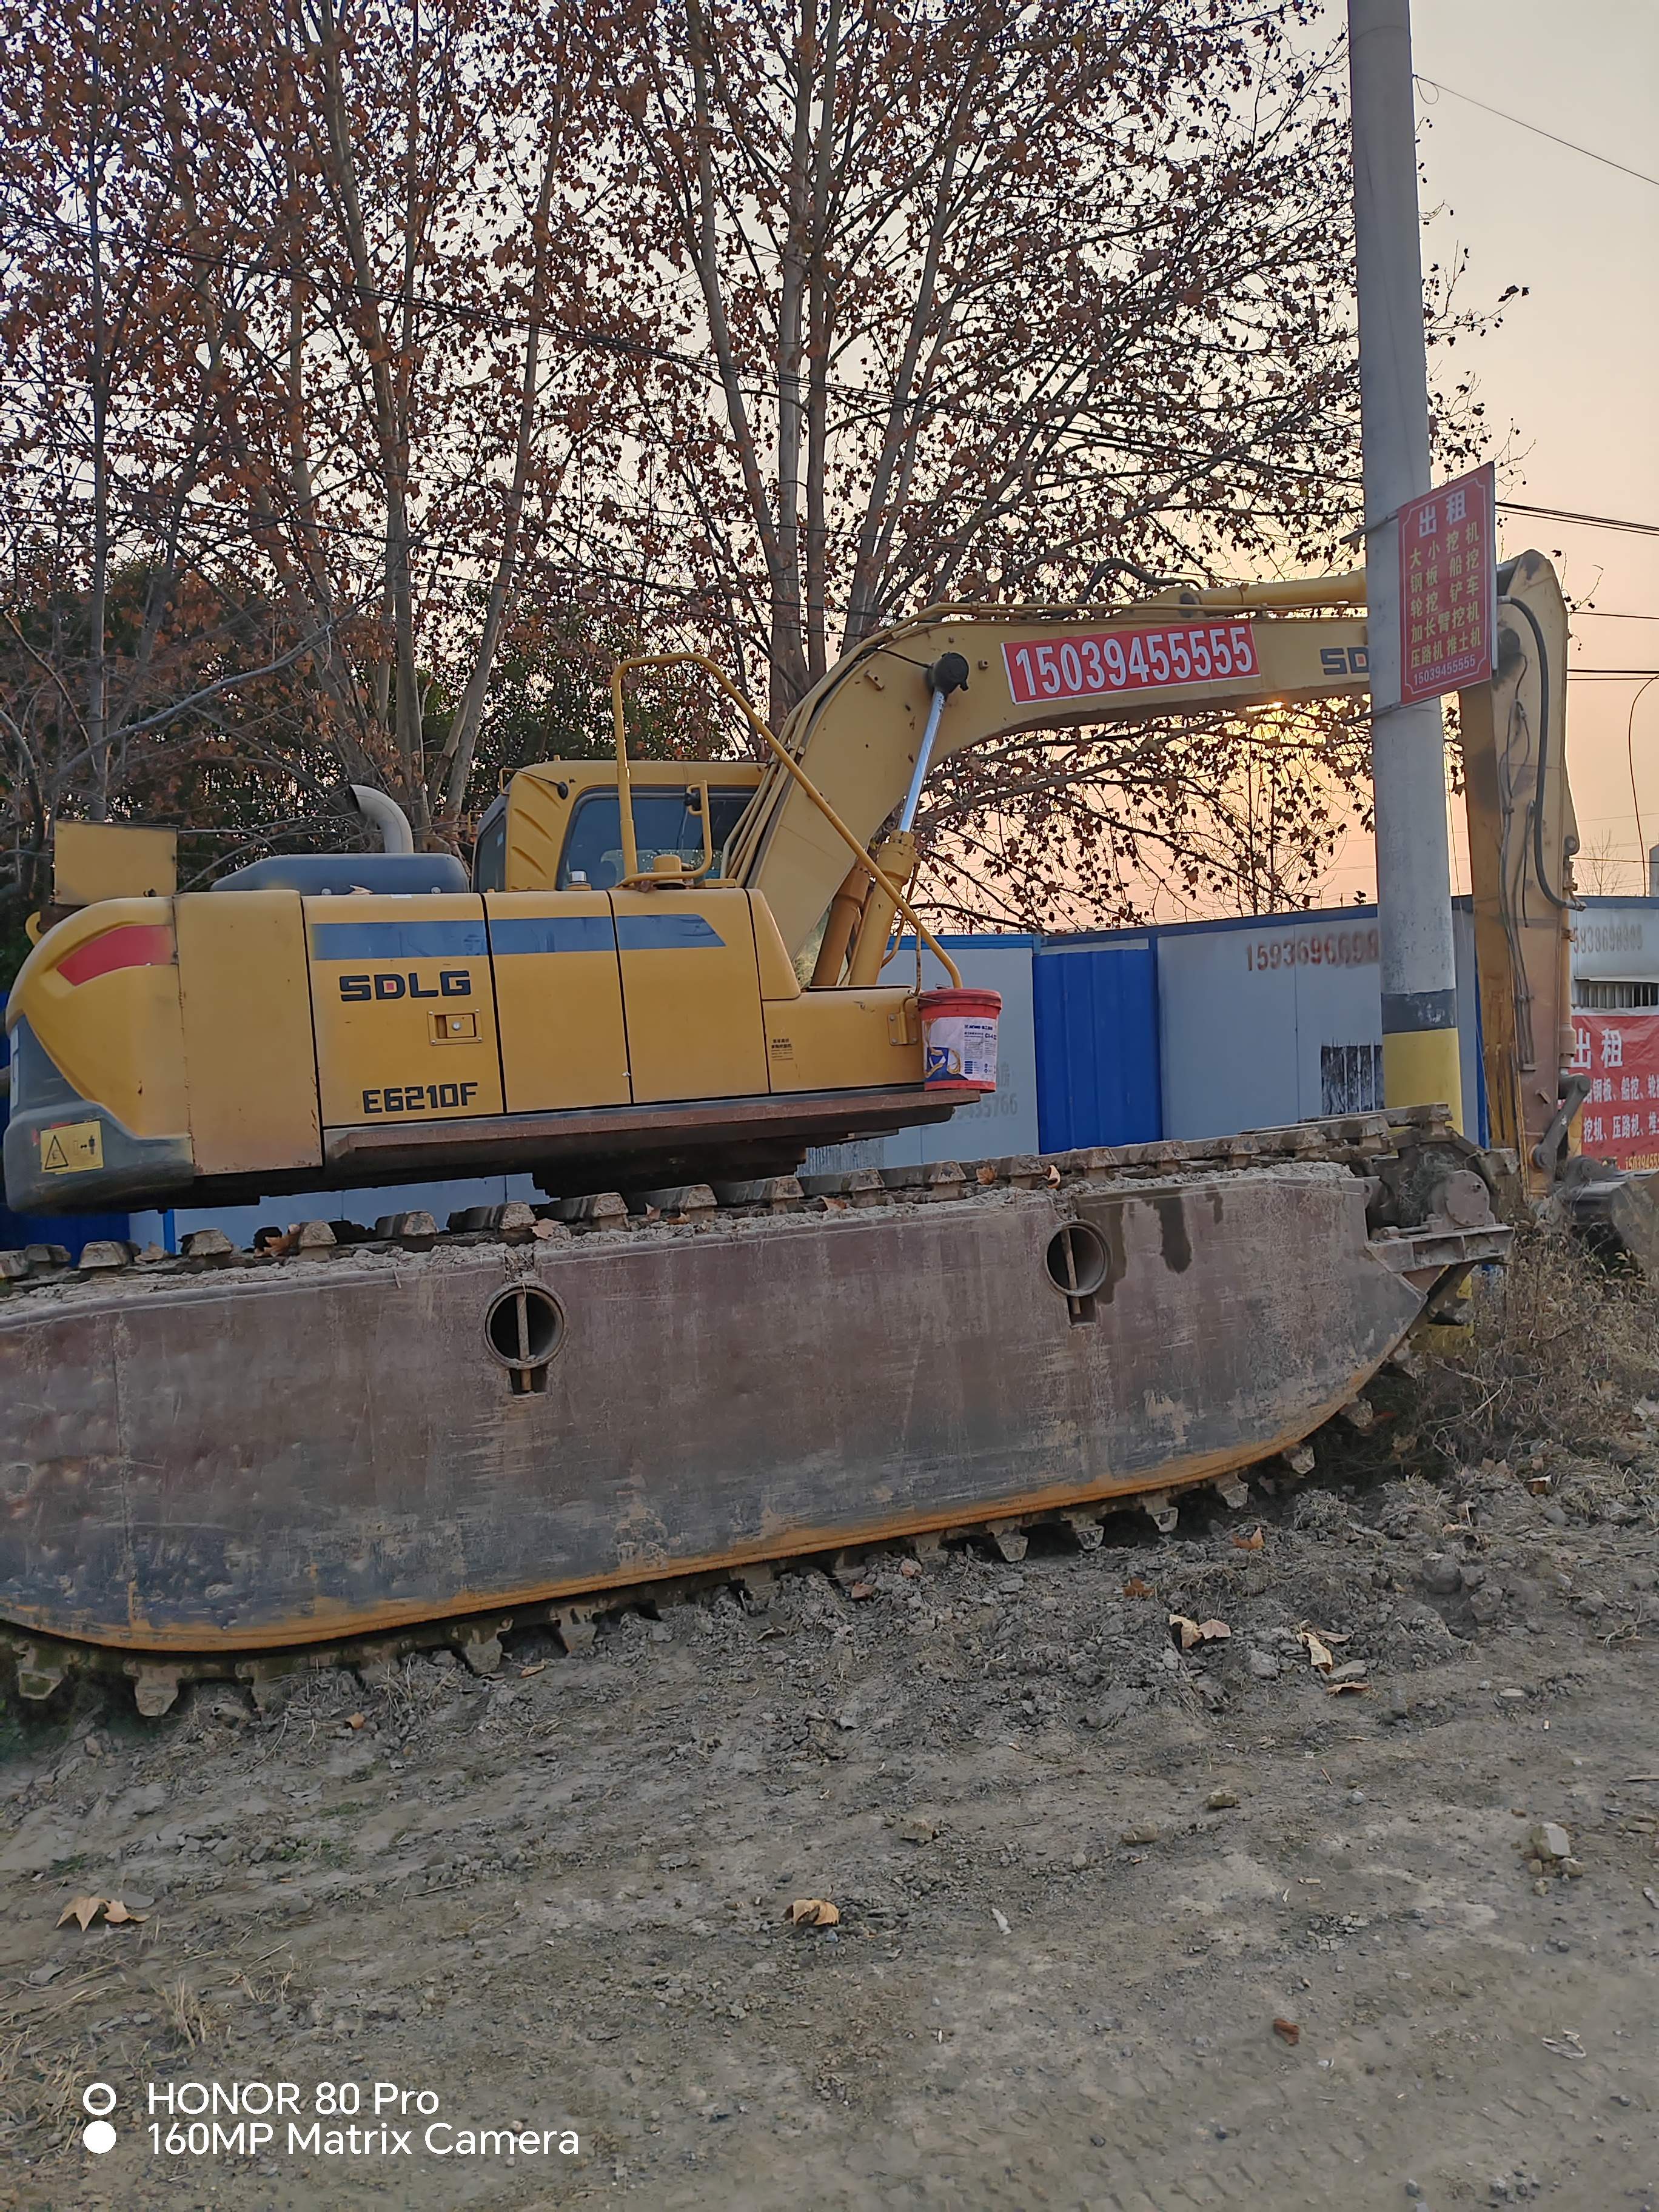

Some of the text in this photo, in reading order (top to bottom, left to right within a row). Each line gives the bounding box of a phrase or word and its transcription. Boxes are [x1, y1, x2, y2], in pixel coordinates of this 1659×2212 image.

[1418, 490, 1466, 538] 出租
[1410, 521, 1480, 570] 大小挖机
[1410, 548, 1480, 594] 钢板 船挖
[1410, 575, 1480, 619] 轮挖 铲车
[1410, 601, 1480, 644] 加长臂挖机
[1015, 626, 1253, 696] 15039455555
[1320, 647, 1369, 675] SD
[1411, 626, 1481, 669] 压路机 推土机
[1414, 654, 1476, 686] 15039455555
[339, 970, 472, 1002] SDLG
[1570, 1028, 1623, 1069] 出租
[362, 1082, 478, 1114] E6210F
[1583, 1111, 1659, 1144] 挖机、压路机、推
